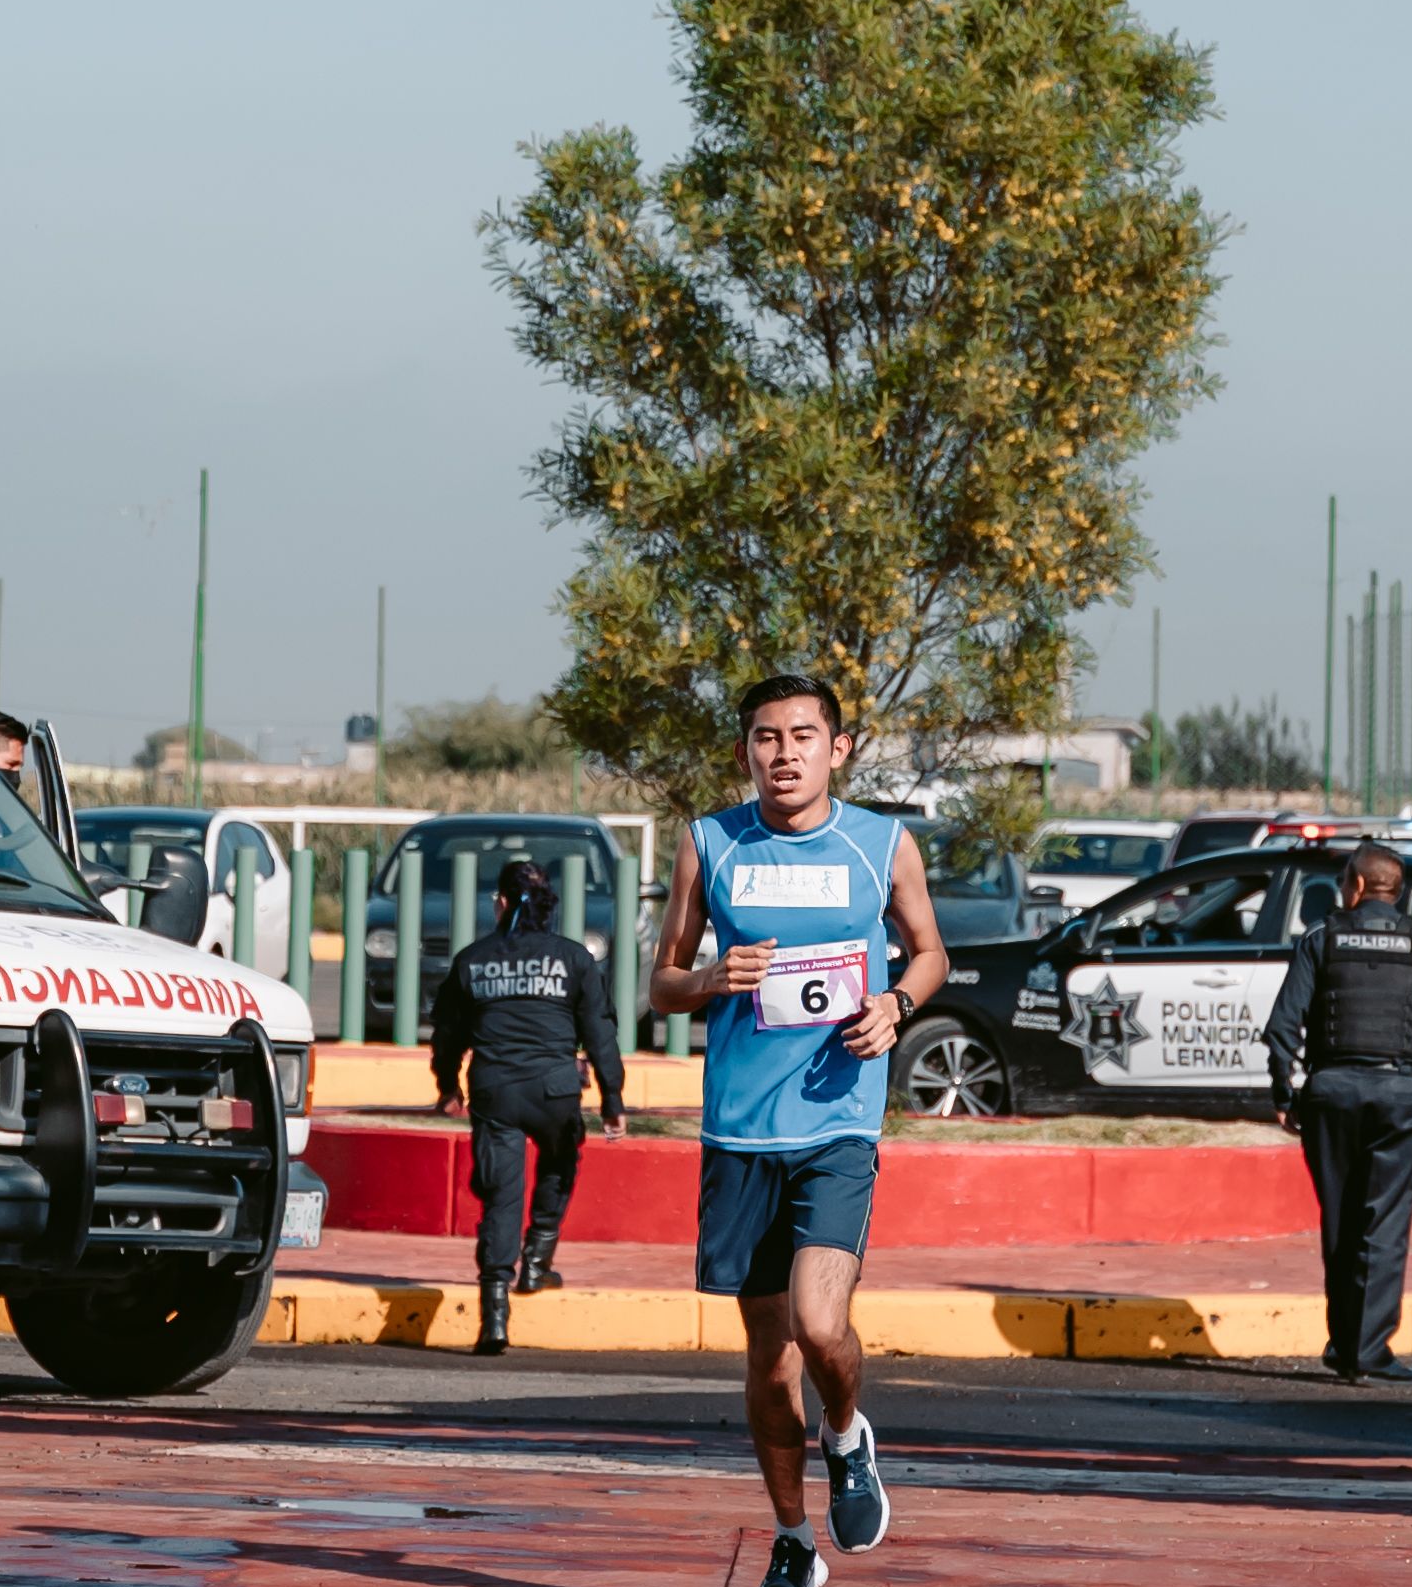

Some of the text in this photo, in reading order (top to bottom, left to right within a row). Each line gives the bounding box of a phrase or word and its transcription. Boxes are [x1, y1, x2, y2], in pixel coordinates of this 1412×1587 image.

[1336, 934, 1407, 948] POLICIA
[469, 955, 568, 980] POLICÍA
[470, 976, 568, 999] MUNICIPAL
[800, 979, 829, 1015] 6
[1162, 1001, 1253, 1022] POLICIA
[1162, 1025, 1264, 1044] MUNICIPA
[1162, 1046, 1245, 1068] LERMA
